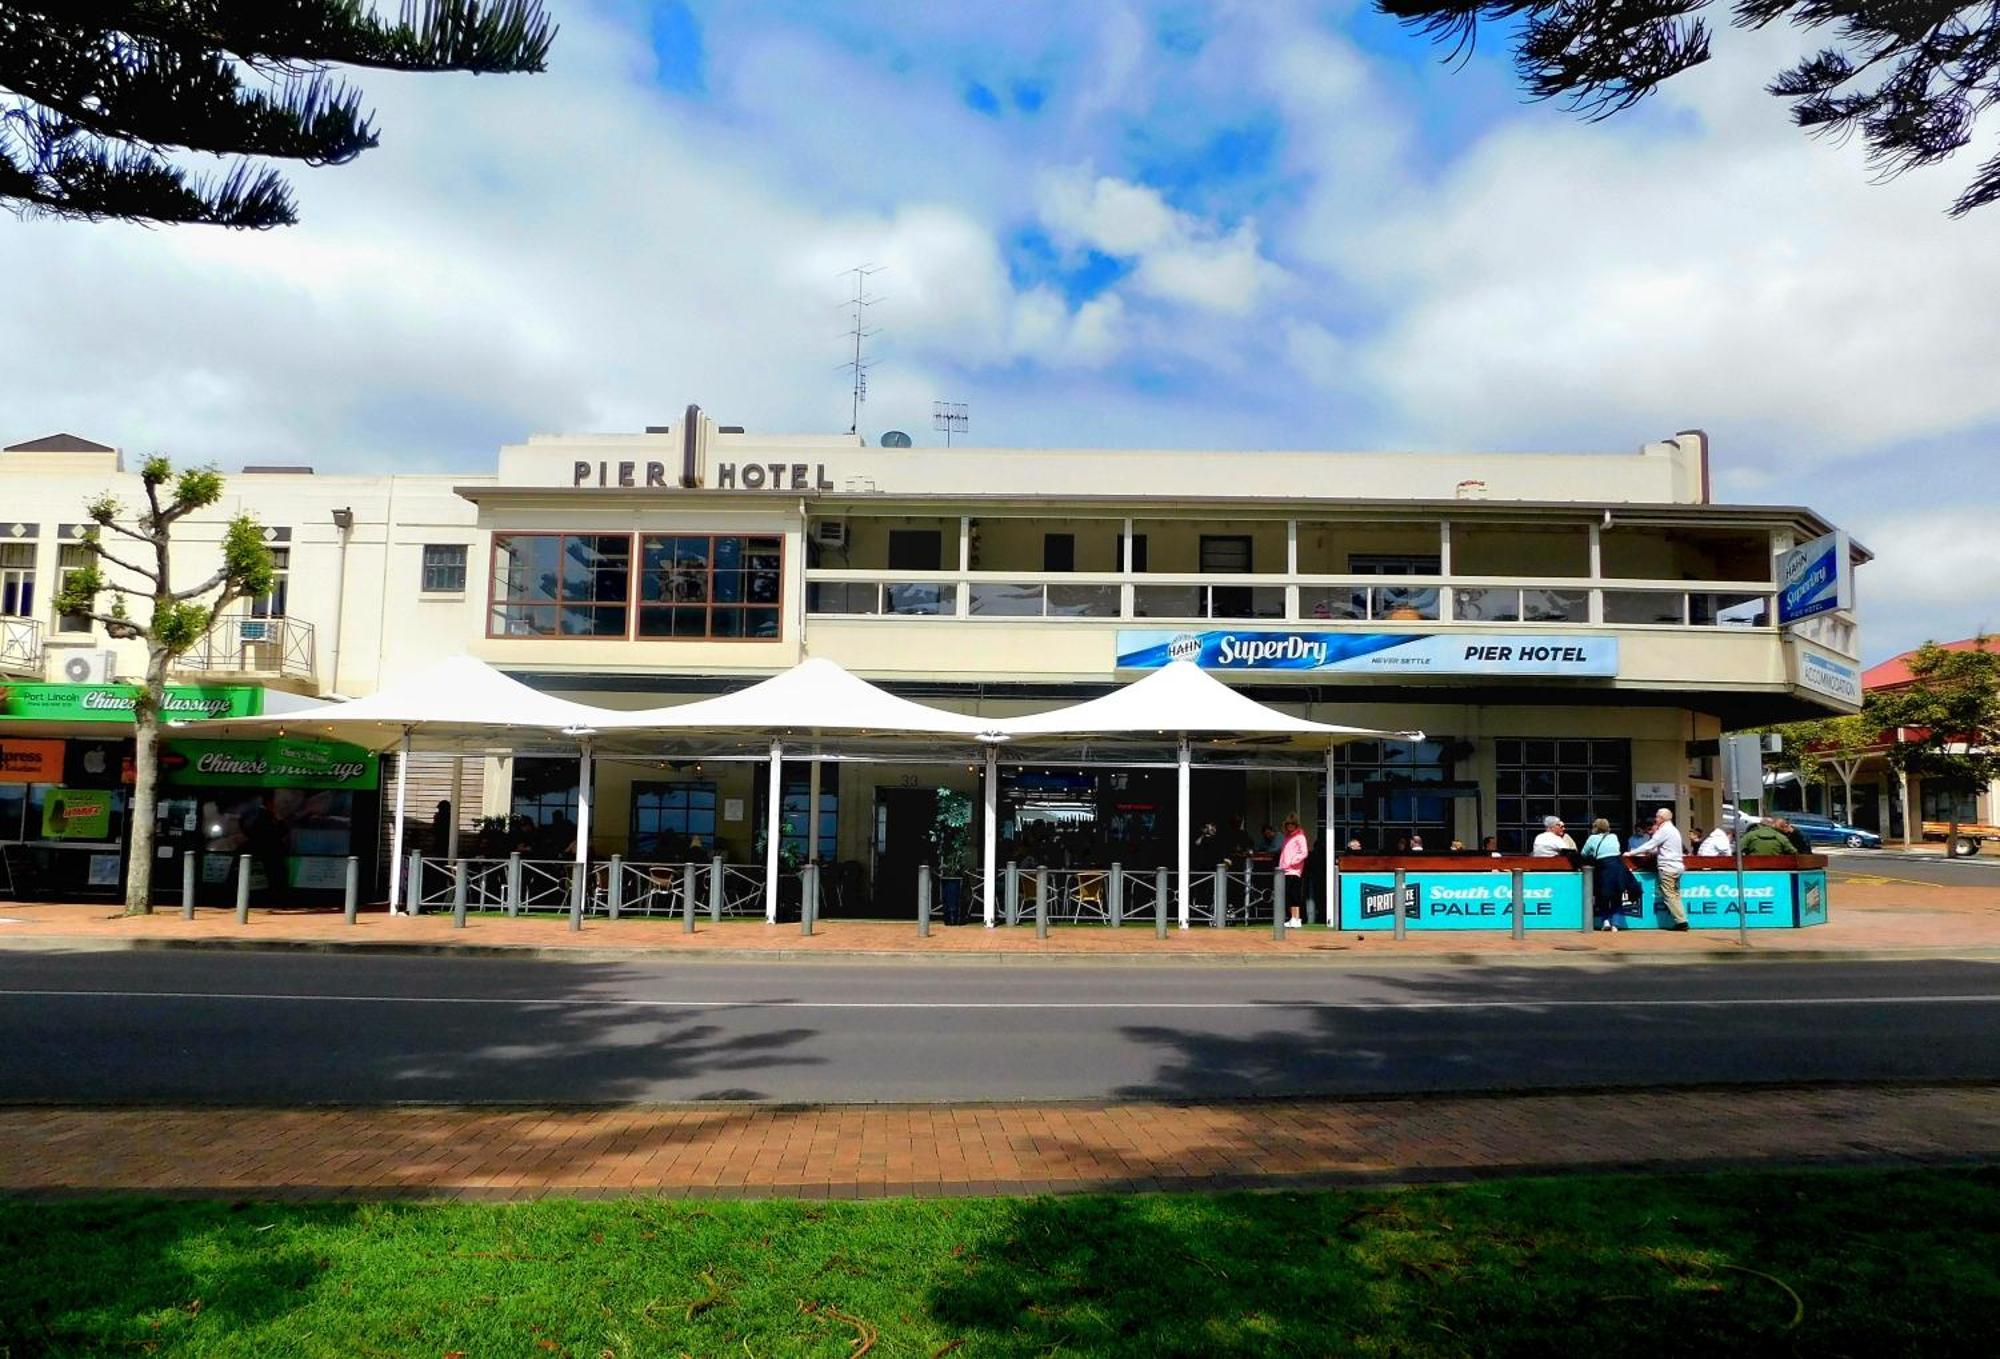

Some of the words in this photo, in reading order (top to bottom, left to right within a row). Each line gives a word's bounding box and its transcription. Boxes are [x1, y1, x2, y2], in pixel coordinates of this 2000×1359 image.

[574, 461, 667, 487] PIER
[718, 463, 833, 489] HOTEL
[1786, 553, 1808, 579] HAHN
[1168, 638, 1202, 657] HAHN
[1218, 636, 1327, 664] SuperDry
[1465, 647, 1513, 661] PIER
[1519, 647, 1587, 662] HOTEL
[24, 692, 44, 701] Port
[196, 753, 268, 775] Chinese
[1430, 885, 1489, 900] South
[1430, 903, 1496, 915] PALE
[1724, 902, 1774, 914] ALE
